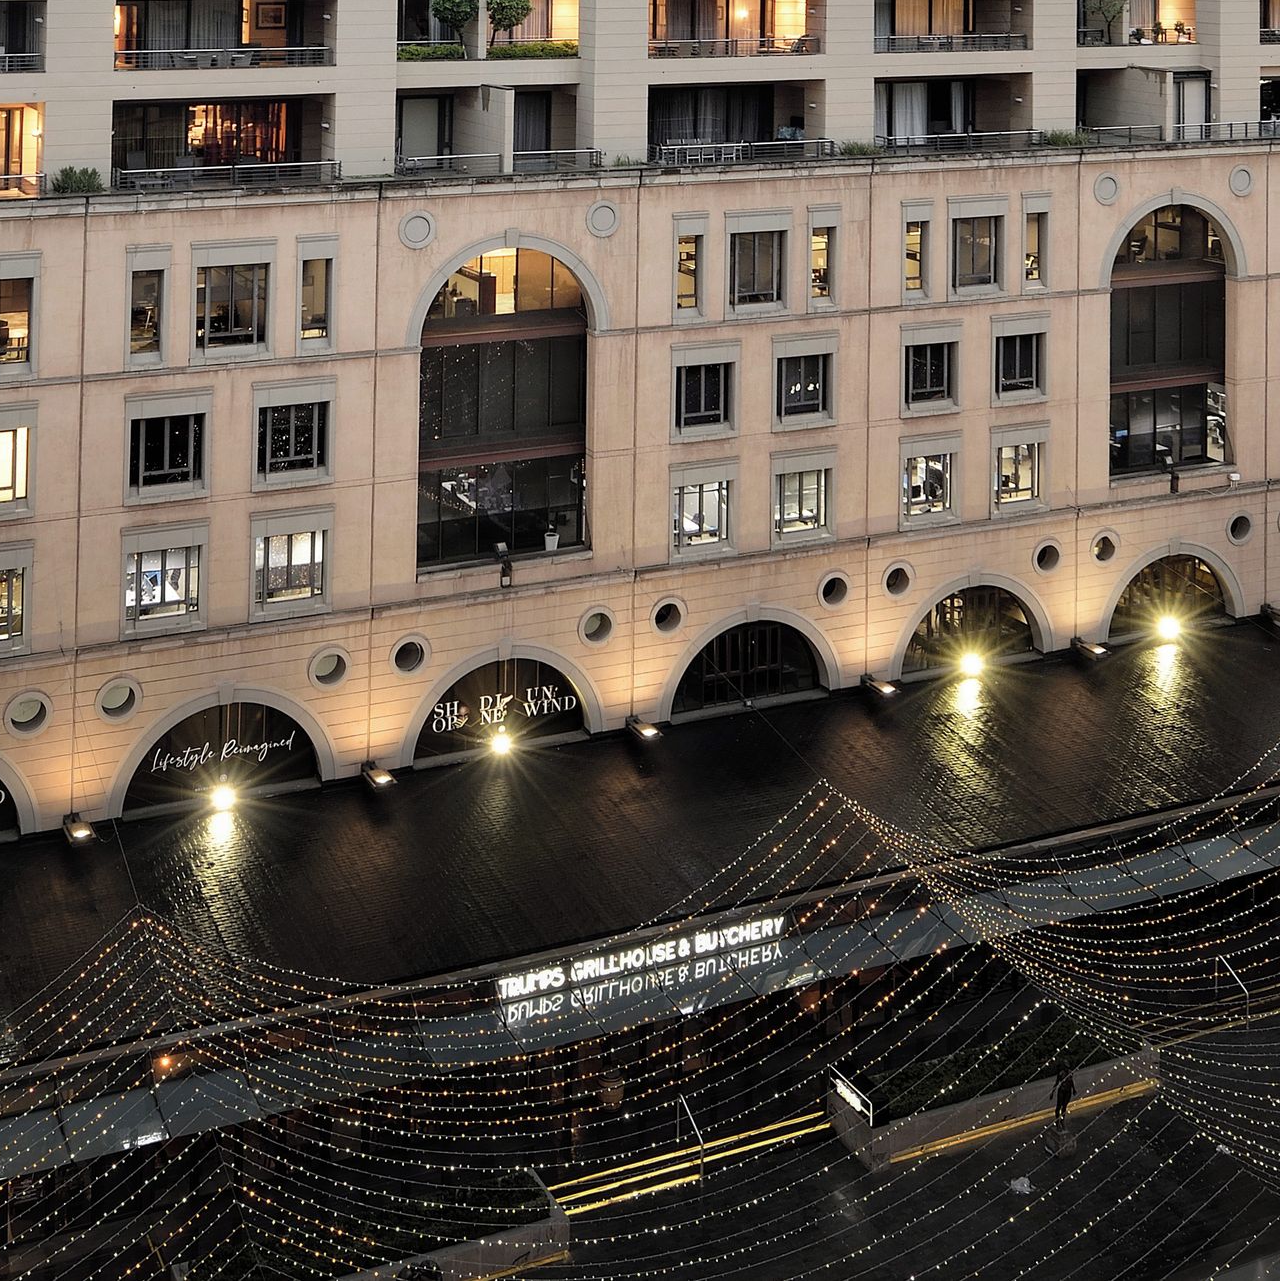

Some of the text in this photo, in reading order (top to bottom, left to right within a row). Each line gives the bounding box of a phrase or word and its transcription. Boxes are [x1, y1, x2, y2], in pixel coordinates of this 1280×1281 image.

[151, 730, 296, 773] Lifestyle Reimagined
[498, 917, 785, 1000] TRUMPS GRILLHOUSE & BUTCHERY
